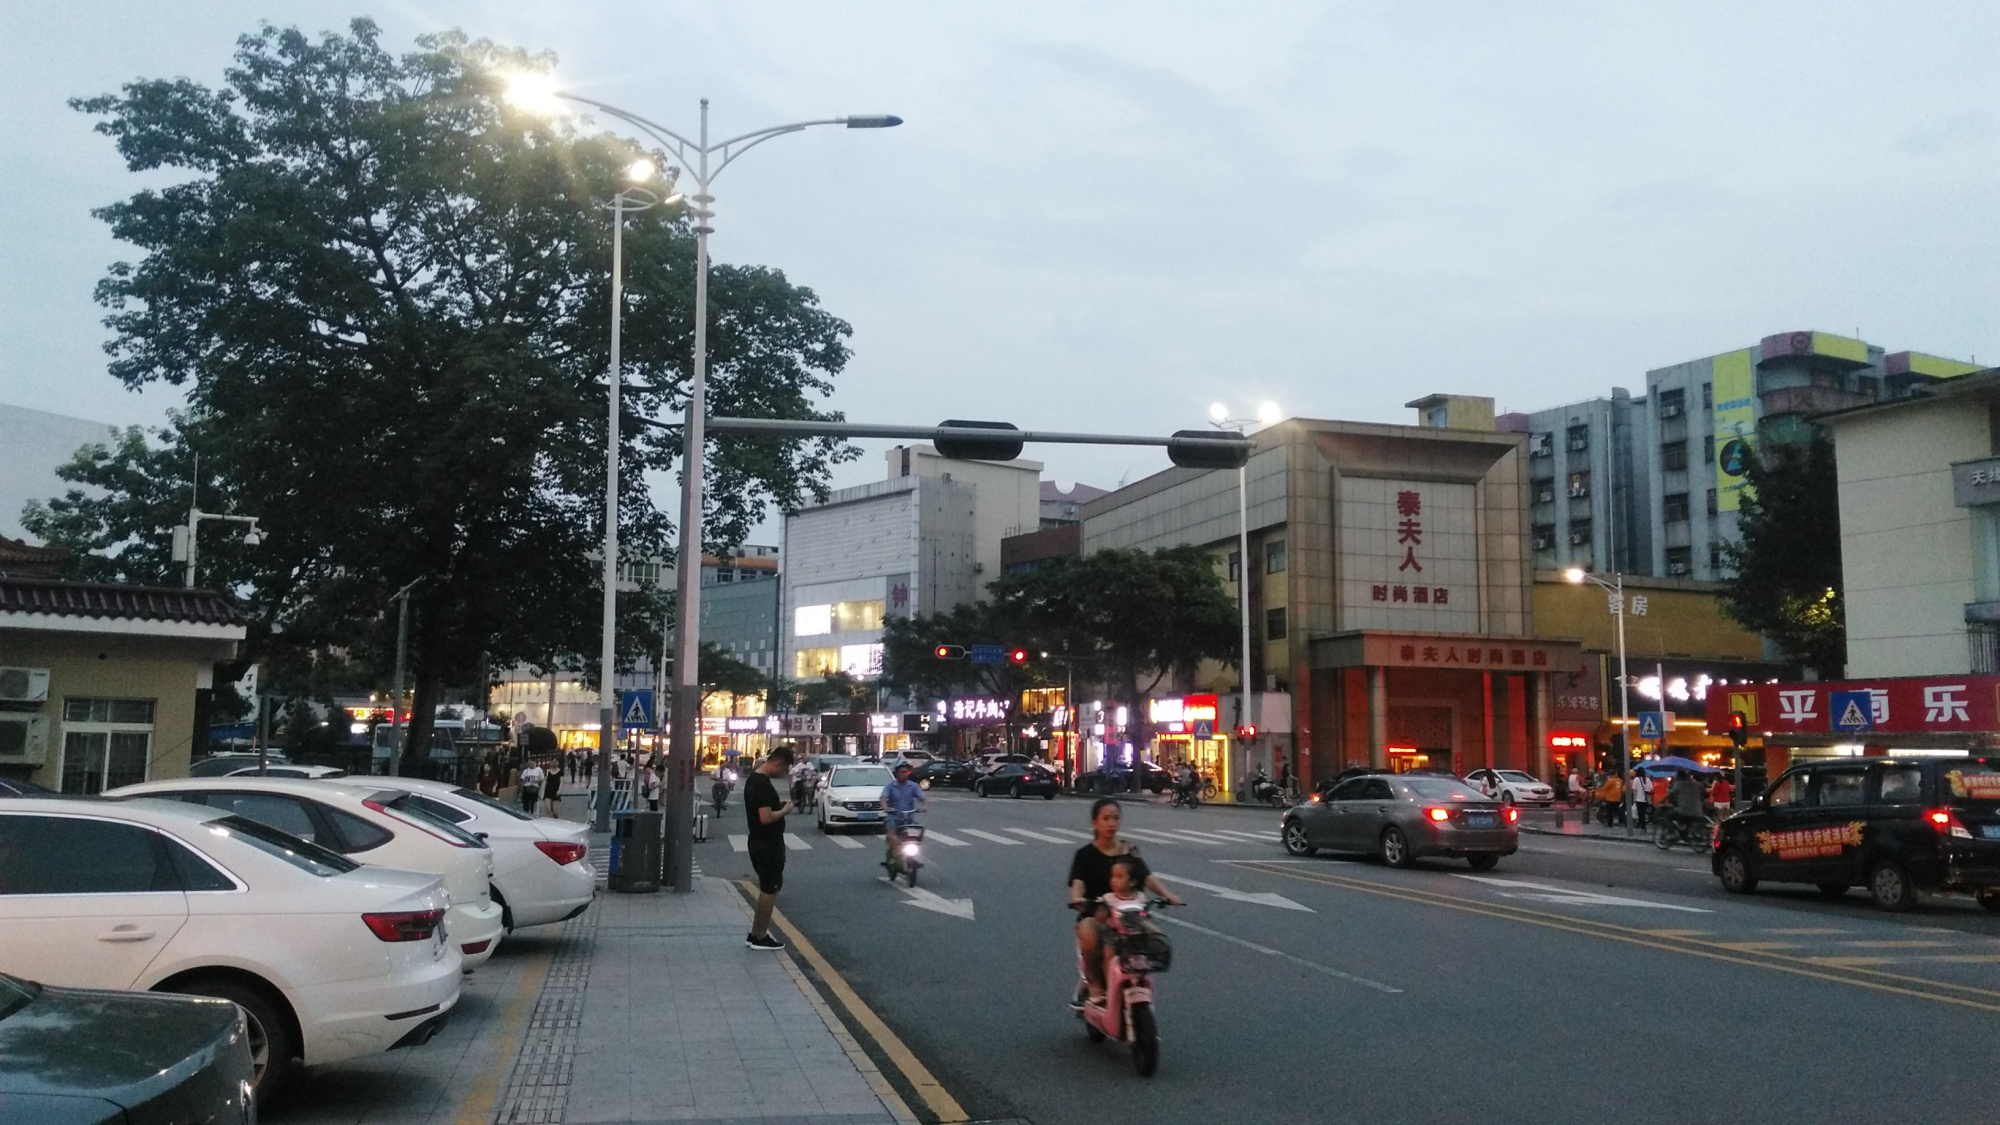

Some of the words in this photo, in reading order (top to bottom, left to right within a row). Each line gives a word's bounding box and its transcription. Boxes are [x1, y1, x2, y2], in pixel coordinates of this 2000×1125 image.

[1372, 585, 1449, 605] 时尚酒店
[1608, 593, 1649, 616] 客房
